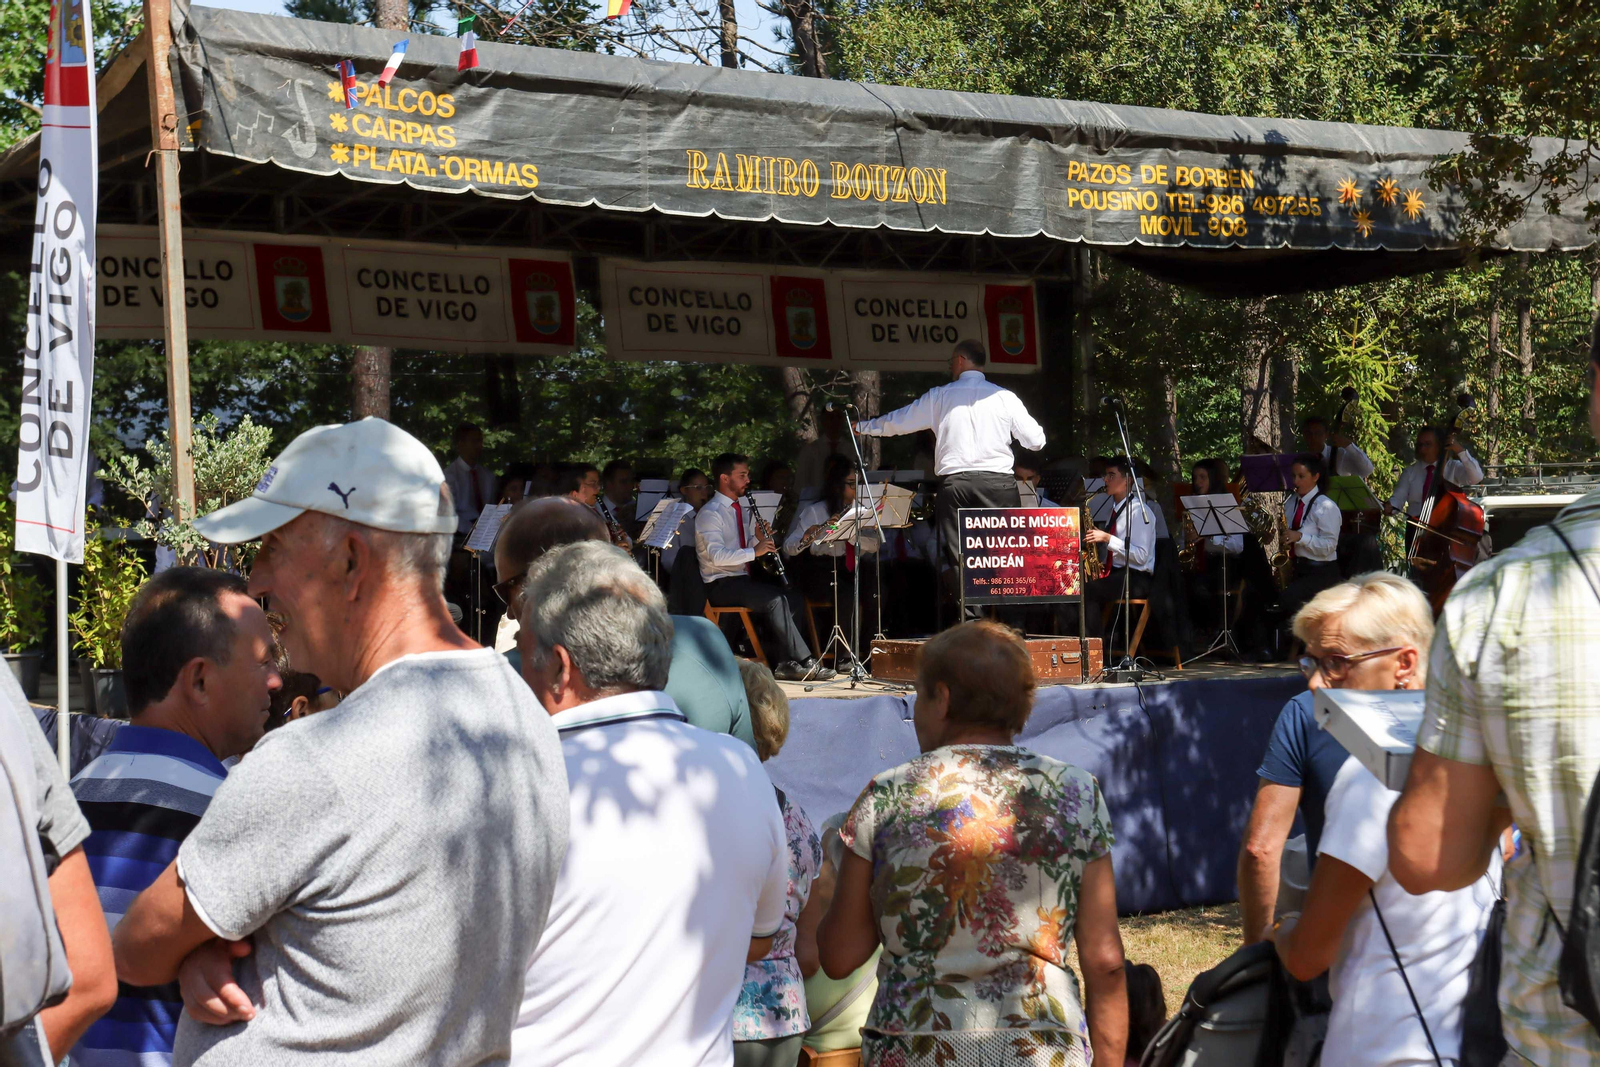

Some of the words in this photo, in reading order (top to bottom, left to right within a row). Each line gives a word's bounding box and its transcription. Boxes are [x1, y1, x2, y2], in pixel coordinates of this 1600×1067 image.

[356, 81, 456, 118] PALCOS
[352, 113, 457, 148] CARPAS
[686, 150, 820, 197] RAMIRO
[830, 161, 947, 205] BOUZON
[1067, 161, 1132, 185] PAZOS
[1140, 164, 1169, 186] DE
[1176, 166, 1255, 189] BORBEN
[1067, 187, 1158, 212] POUSIÑO
[1252, 195, 1322, 217] 497255
[1140, 214, 1199, 236] MOVIL
[1207, 216, 1248, 237] 908
[49, 200, 77, 353] VIGO
[96, 256, 234, 281] ONCLLO
[357, 268, 491, 296] CONCELLO
[102, 285, 140, 307] DE
[150, 285, 219, 309] VGO
[629, 286, 752, 312] CONCELLO
[854, 297, 968, 320] CONCELLO
[376, 298, 409, 319] DE
[416, 299, 477, 322] VIGO
[646, 313, 679, 334] DE
[684, 315, 742, 337] VIGO
[871, 323, 900, 343] DE
[907, 324, 959, 344] VIGO
[48, 378, 73, 459] DE
[965, 516, 1008, 529] BANDA
[1010, 516, 1026, 528] DE
[1029, 513, 1074, 528] MÚSICA
[966, 536, 984, 549] DA
[986, 535, 1031, 548] U.V.C.D.
[1033, 535, 1049, 547] DE
[966, 553, 1024, 569] CANDEÁN
[990, 587, 1002, 595] 661
